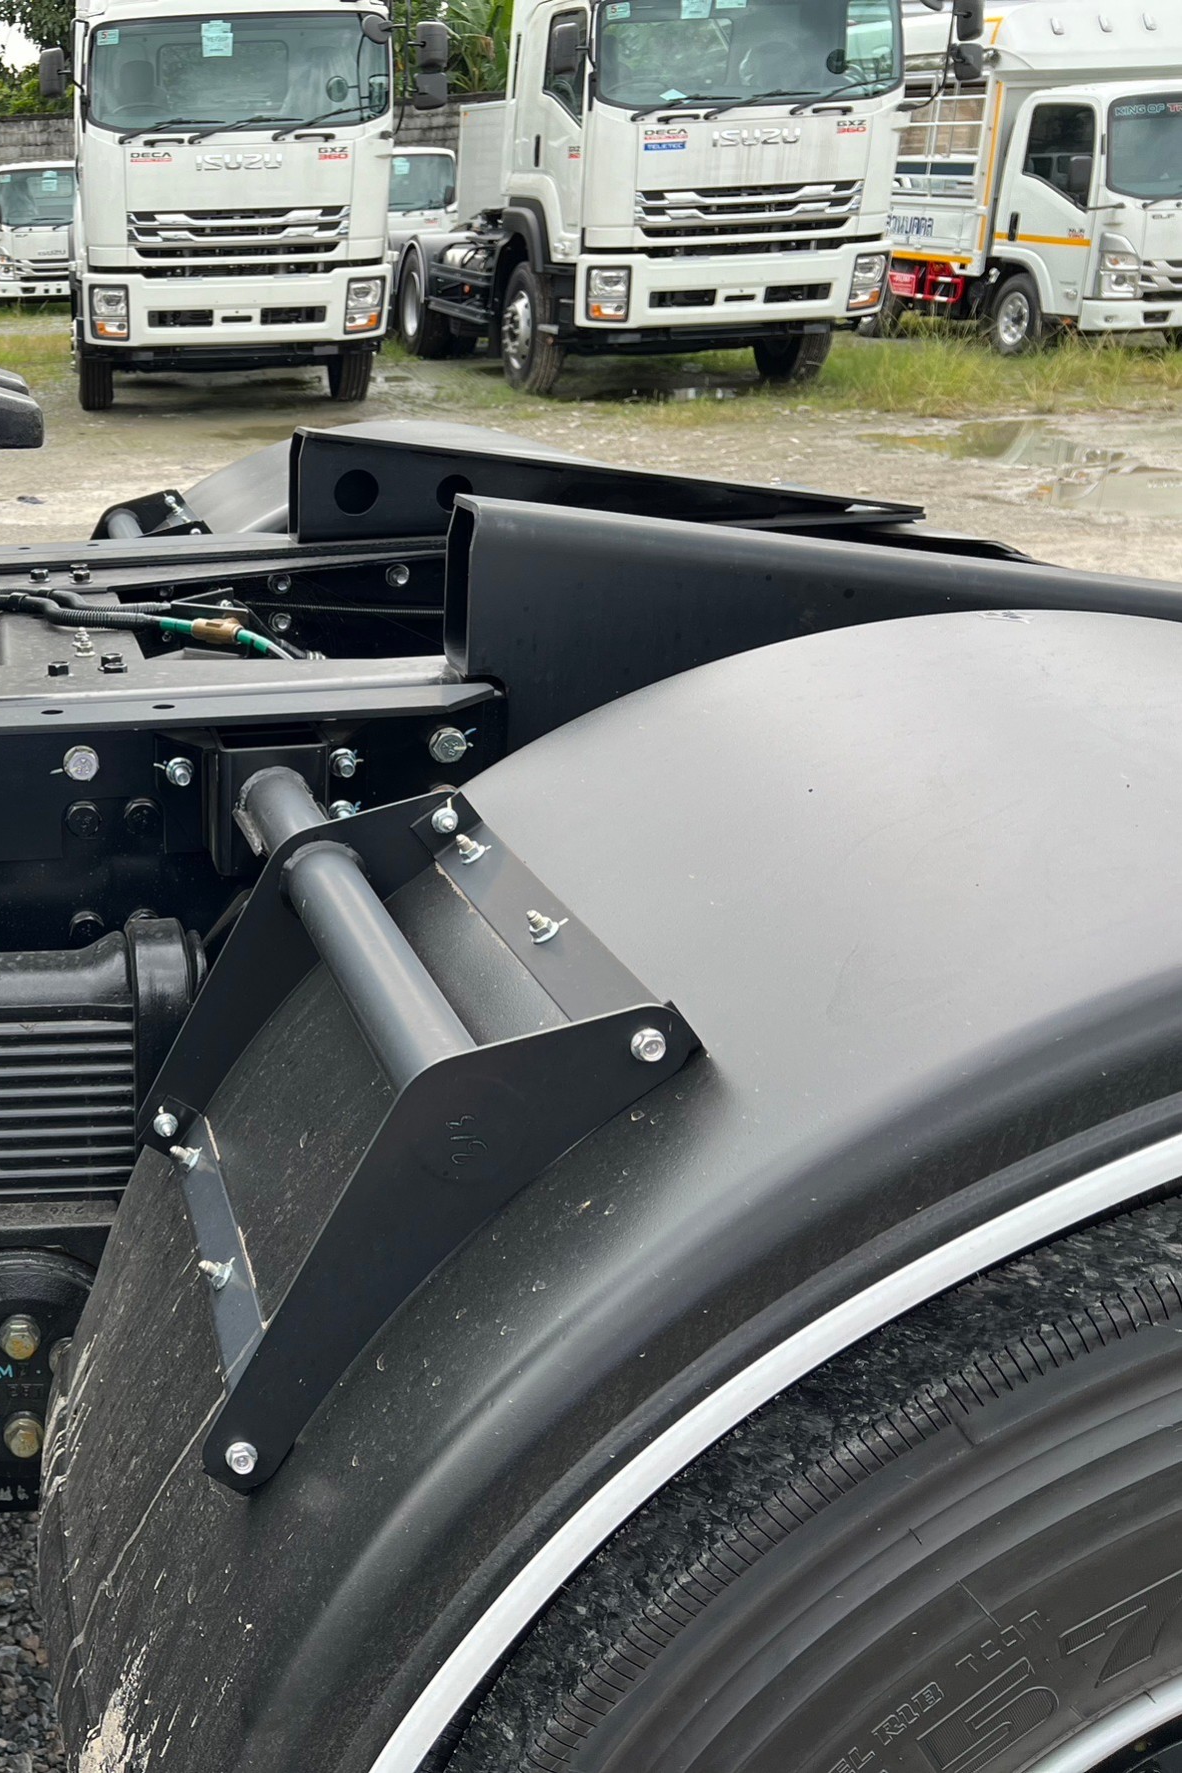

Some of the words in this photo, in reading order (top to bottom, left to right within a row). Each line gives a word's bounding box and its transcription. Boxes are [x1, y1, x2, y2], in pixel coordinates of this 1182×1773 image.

[1114, 104, 1146, 116] KING
[1147, 102, 1166, 113] OF
[836, 126, 867, 134] 360
[837, 119, 867, 127] GXZ
[644, 128, 688, 136] DECA
[711, 127, 801, 147] ISUZU
[195, 152, 283, 171] ISUZU
[871, 1681, 945, 1746] RIB
